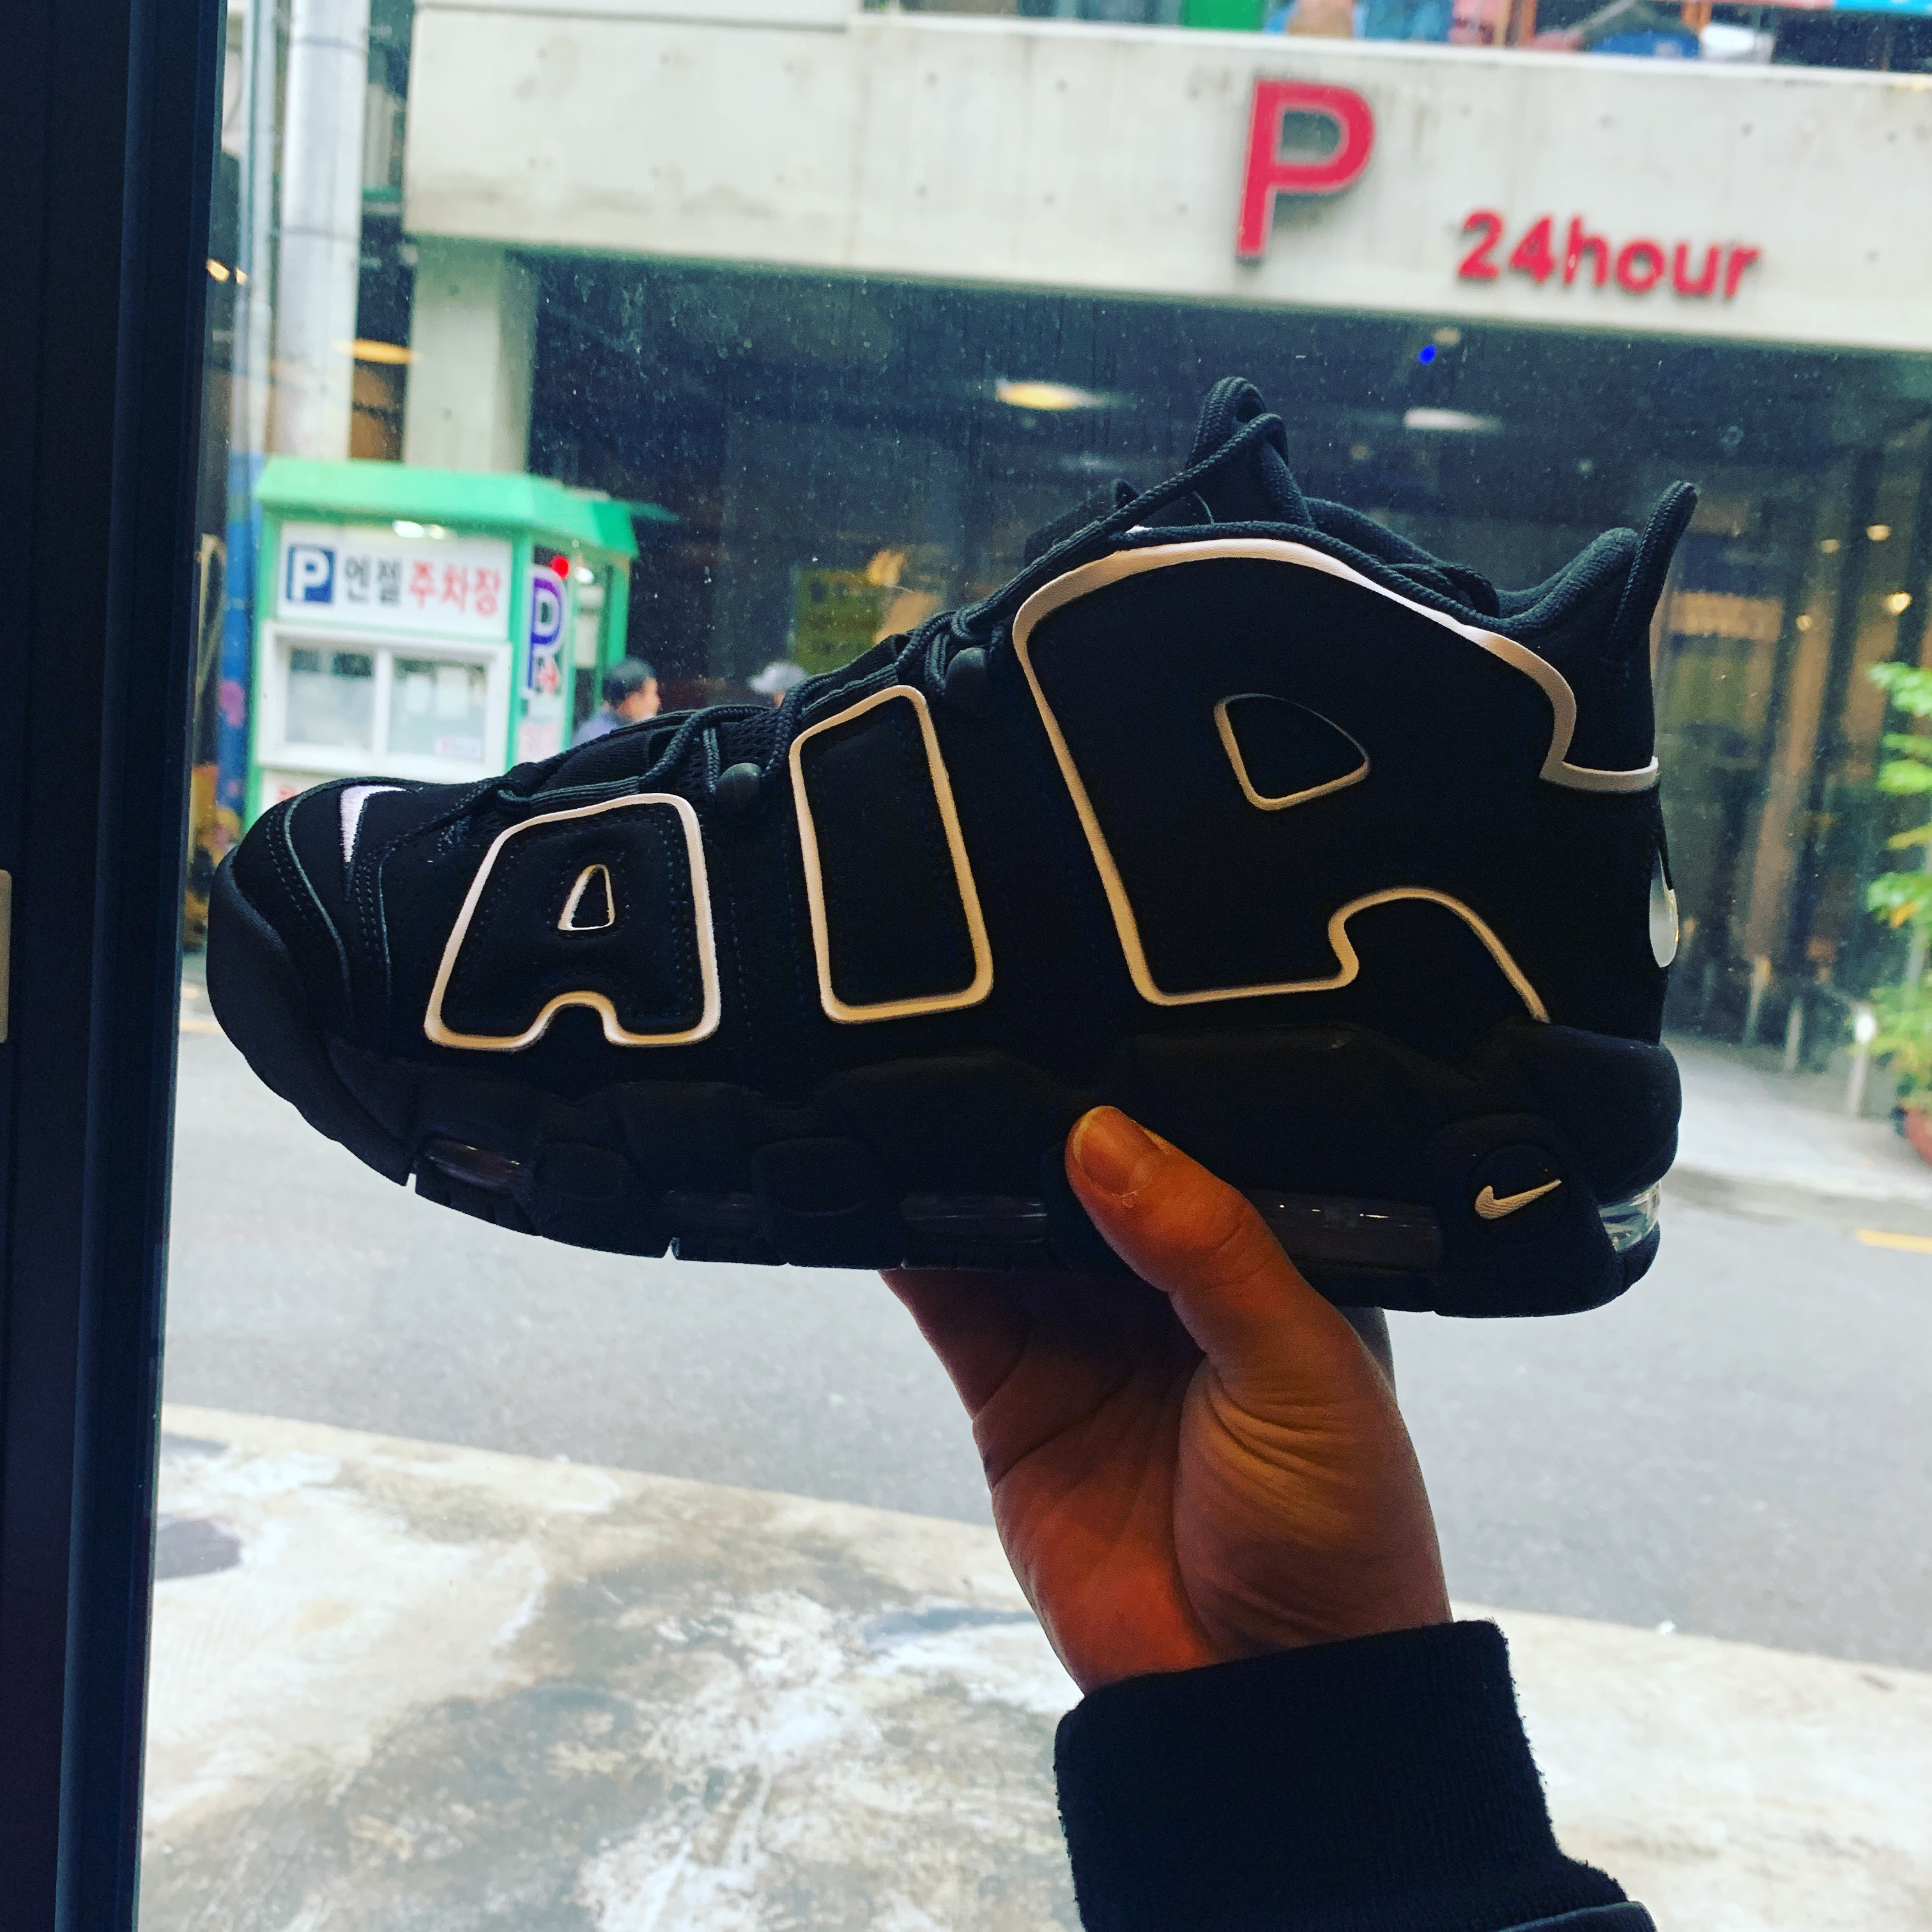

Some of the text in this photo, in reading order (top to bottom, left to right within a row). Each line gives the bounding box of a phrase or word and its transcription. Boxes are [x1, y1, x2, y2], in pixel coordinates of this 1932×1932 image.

[1236, 80, 1375, 257] P
[1457, 208, 1761, 299] 24hour
[289, 548, 332, 603] P
[409, 560, 502, 617] 주차장
